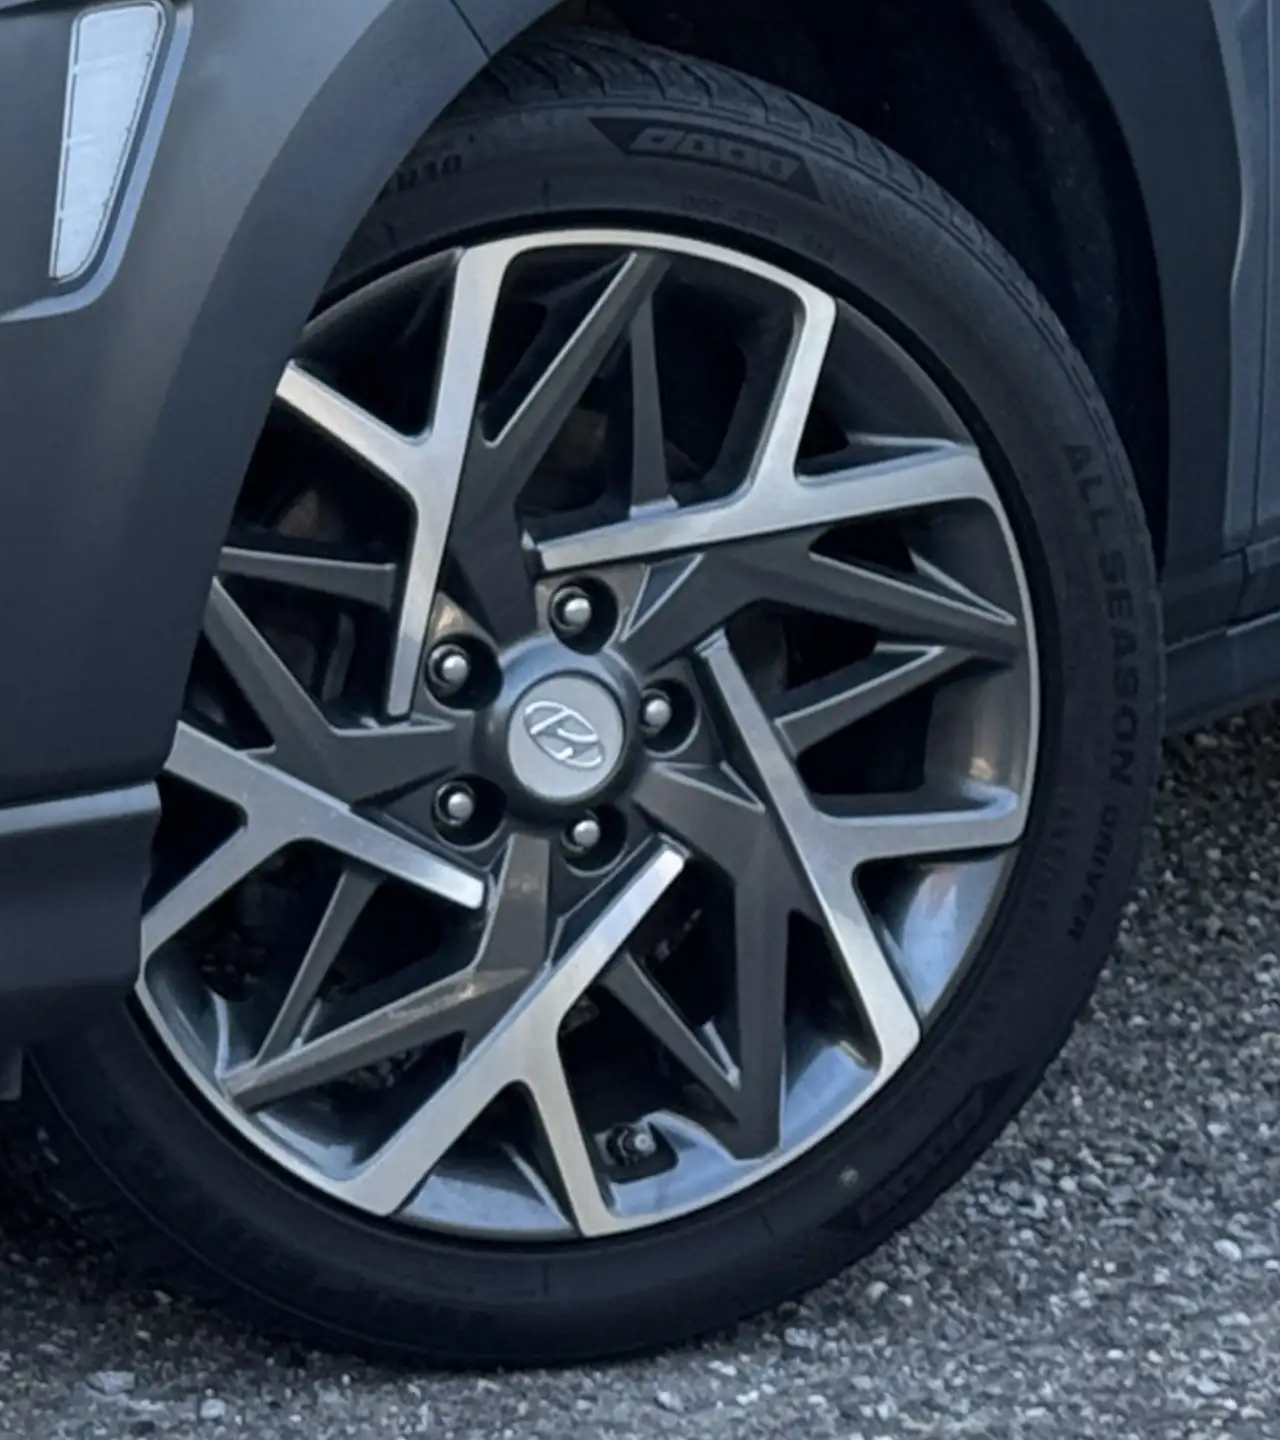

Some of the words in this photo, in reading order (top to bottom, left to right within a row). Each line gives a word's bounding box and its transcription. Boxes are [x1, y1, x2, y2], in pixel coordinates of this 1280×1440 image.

[1061, 442, 1108, 537] ALL
[1096, 548, 1140, 788] SEASON
[1067, 803, 1119, 944] DRIVER
